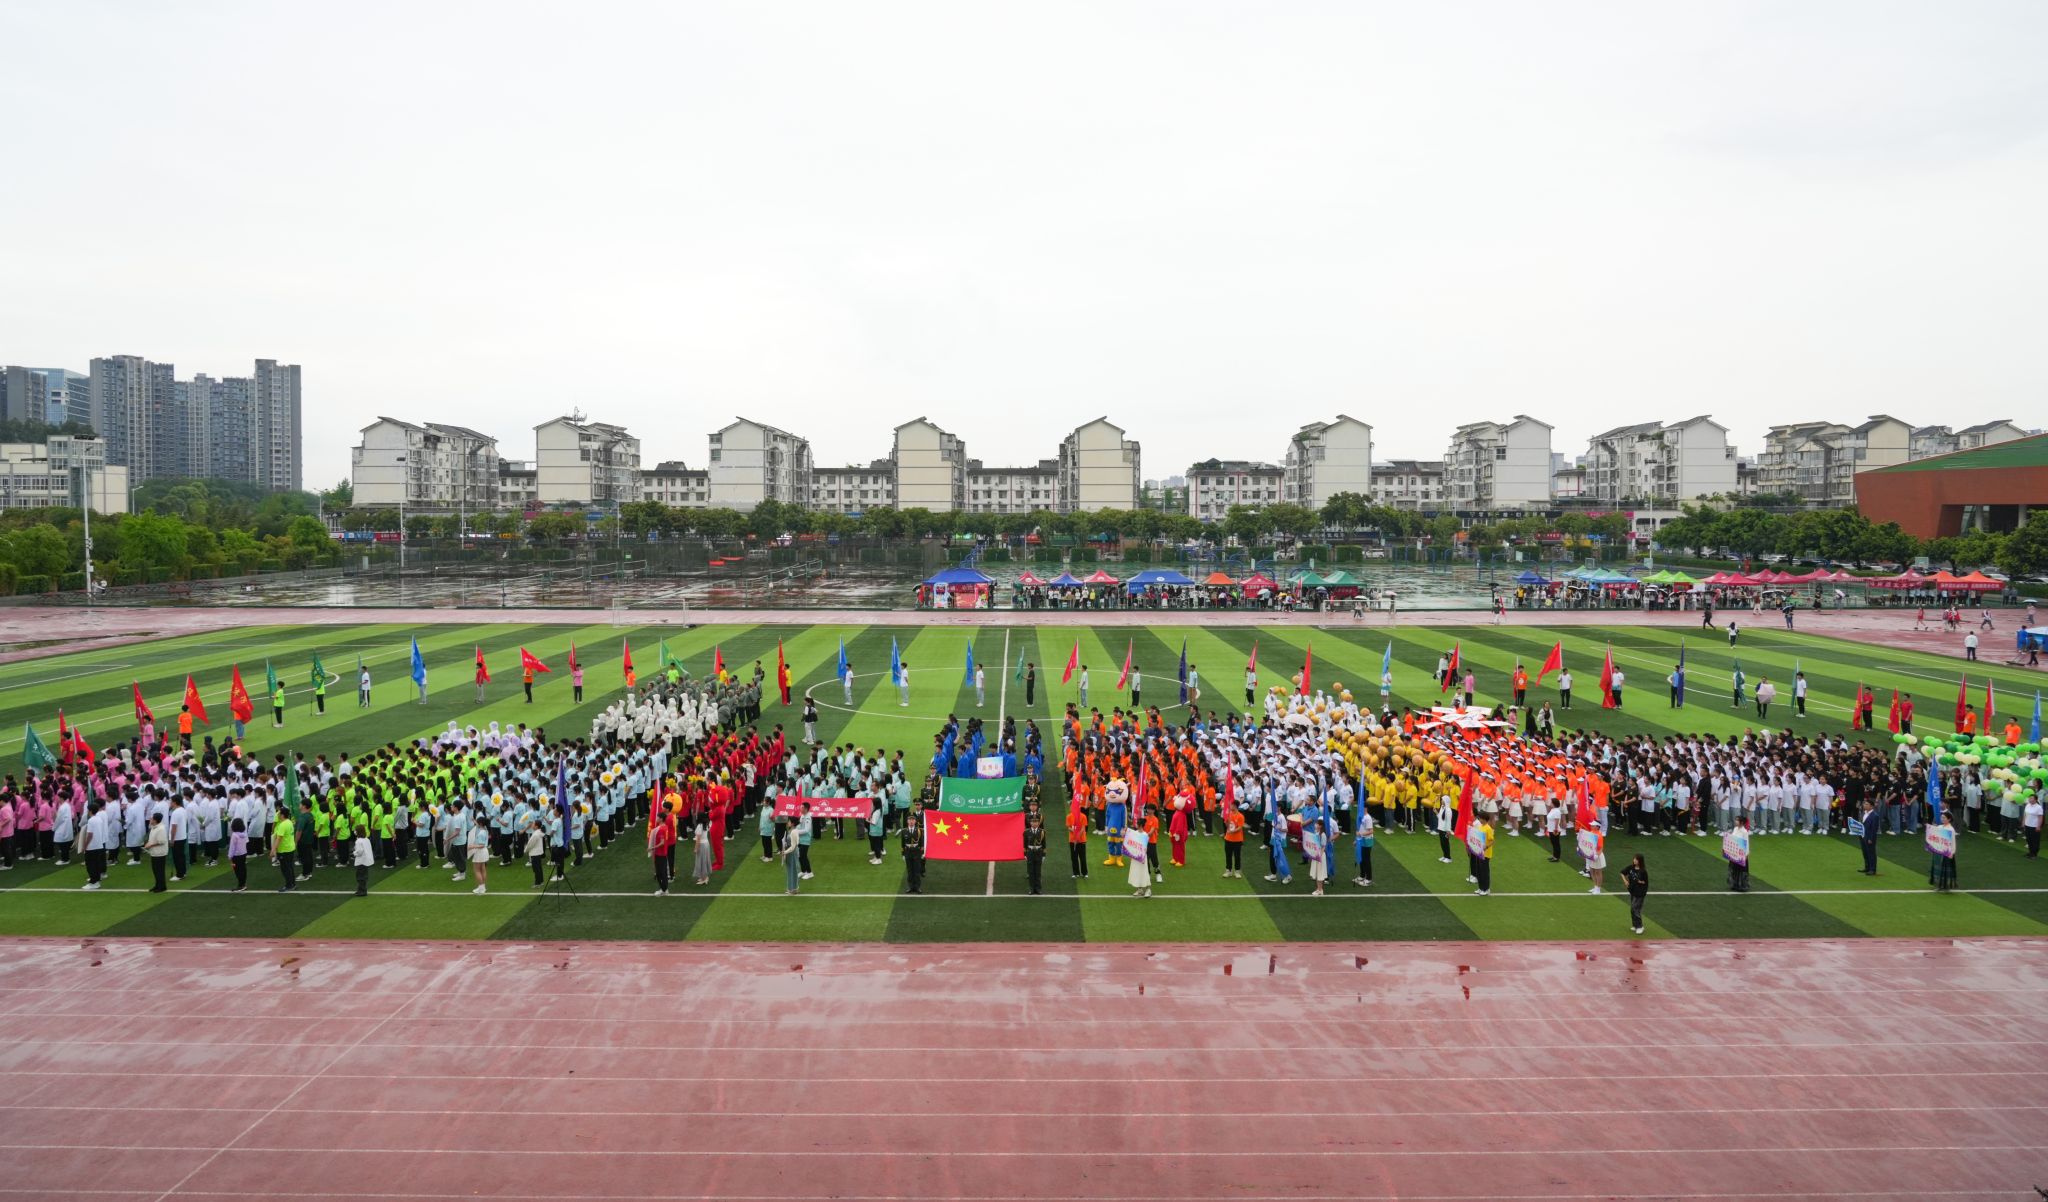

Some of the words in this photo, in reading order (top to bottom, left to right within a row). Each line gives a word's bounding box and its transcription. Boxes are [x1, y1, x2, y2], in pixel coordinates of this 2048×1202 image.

[786, 803, 859, 812] 四农业大学
